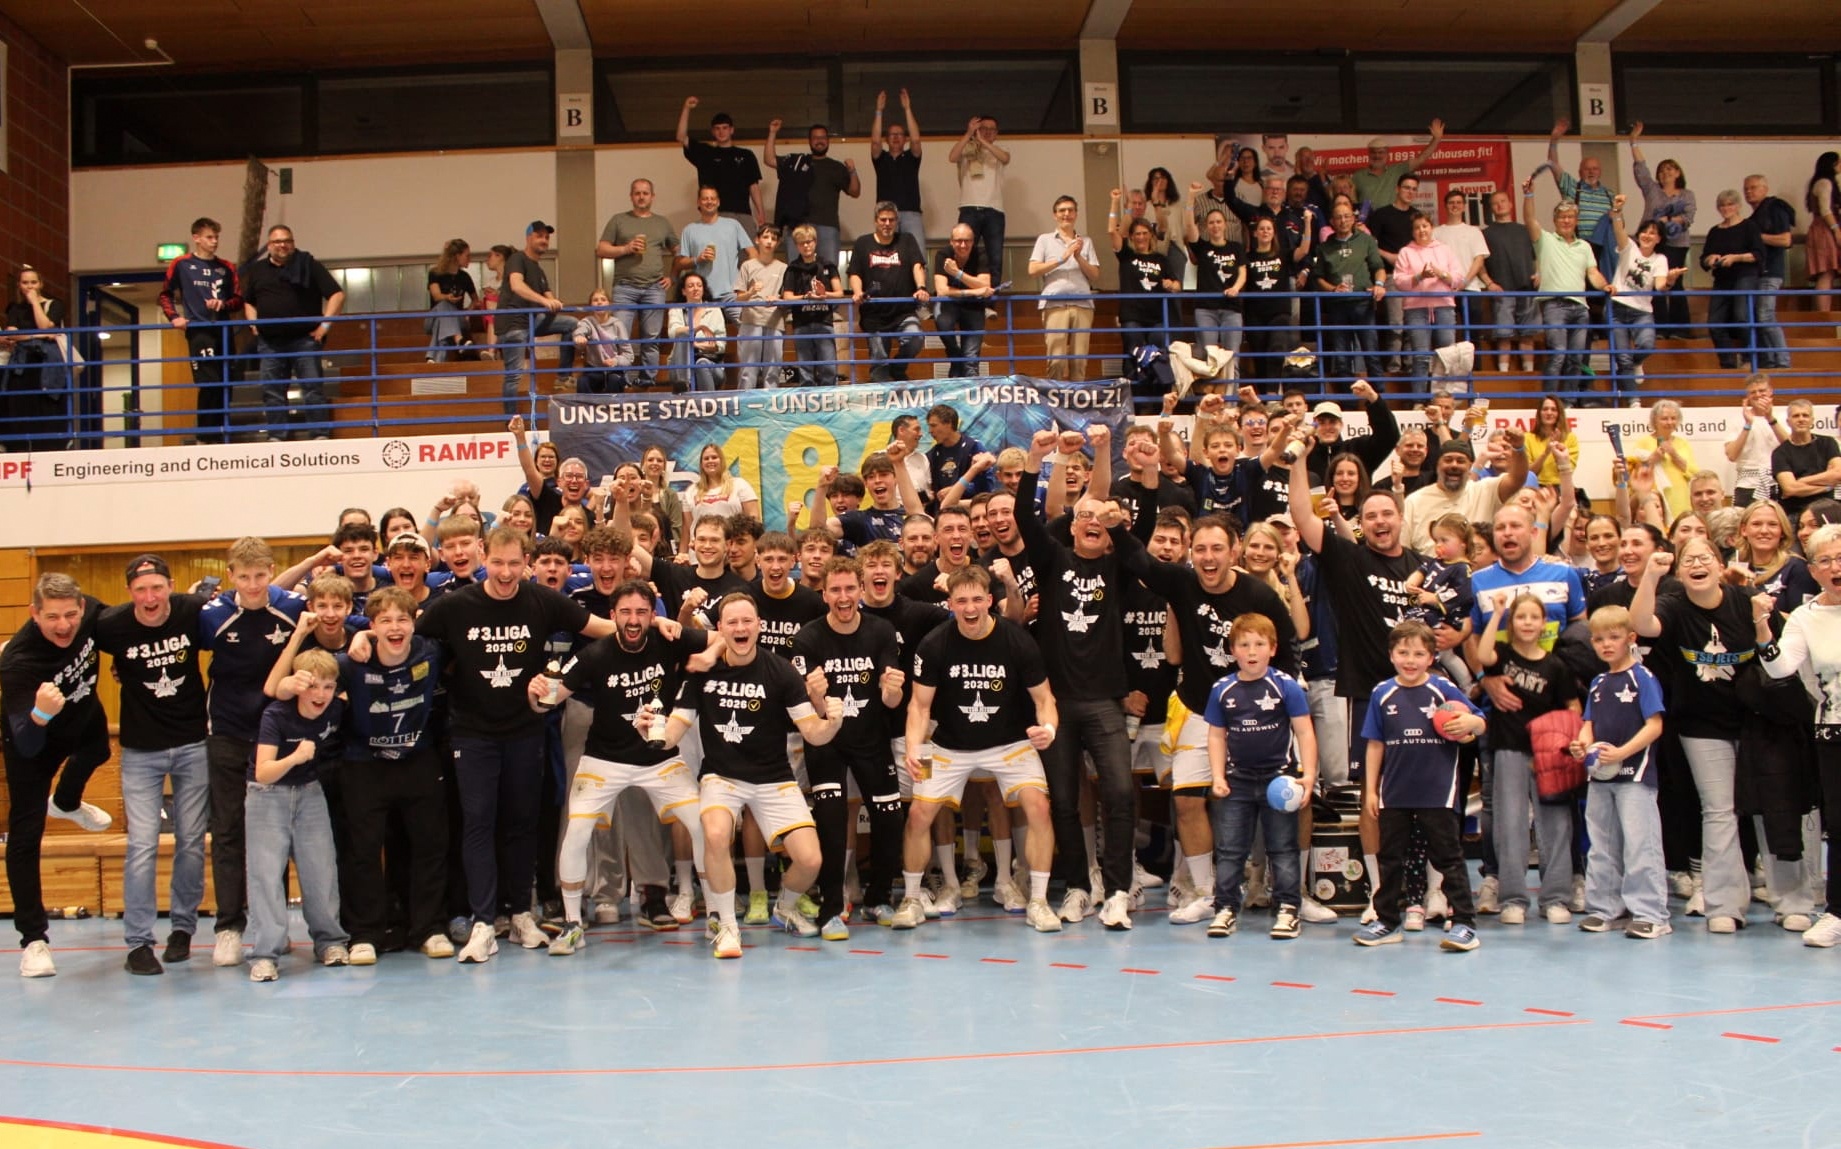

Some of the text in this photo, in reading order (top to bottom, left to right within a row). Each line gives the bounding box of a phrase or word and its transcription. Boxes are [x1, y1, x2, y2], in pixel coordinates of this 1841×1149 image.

[1093, 97, 1108, 115] B
[1590, 98, 1604, 115] B
[567, 108, 582, 127] B
[1329, 155, 1369, 165] machen
[1478, 146, 1493, 158] fit!
[559, 401, 651, 425] UNSERE
[658, 396, 741, 420] STADT!
[771, 391, 850, 414] UNSER
[858, 388, 934, 410] TEAM!
[965, 385, 1041, 406] UNSER
[1048, 387, 1123, 408] STOLZ!
[1699, 419, 1727, 432] and
[54, 459, 154, 480] Engineering
[160, 457, 192, 474] and
[196, 453, 275, 472] Chemical
[280, 450, 361, 469] Solutions
[418, 440, 511, 463] RAMPF
[1124, 611, 1167, 624] #3.LIG
[468, 624, 531, 641] #3.LIGA
[1138, 626, 1162, 636] 2026
[126, 633, 192, 660] #3.LIGA
[485, 642, 514, 653] 2026
[761, 635, 786, 646] 2026
[54, 637, 95, 687] #3.LIGA
[146, 656, 176, 669] 2026
[824, 656, 874, 674] #3.LIGA
[69, 660, 90, 684] 2026
[607, 663, 666, 689] #3.LIGA
[836, 673, 860, 685] 2026
[949, 664, 1006, 679] #3.LIGA
[625, 684, 651, 699] 2026
[703, 679, 766, 700] #3.LIGA
[963, 680, 990, 691] 2026
[720, 697, 747, 709] 2026
[392, 711, 405, 734] 7
